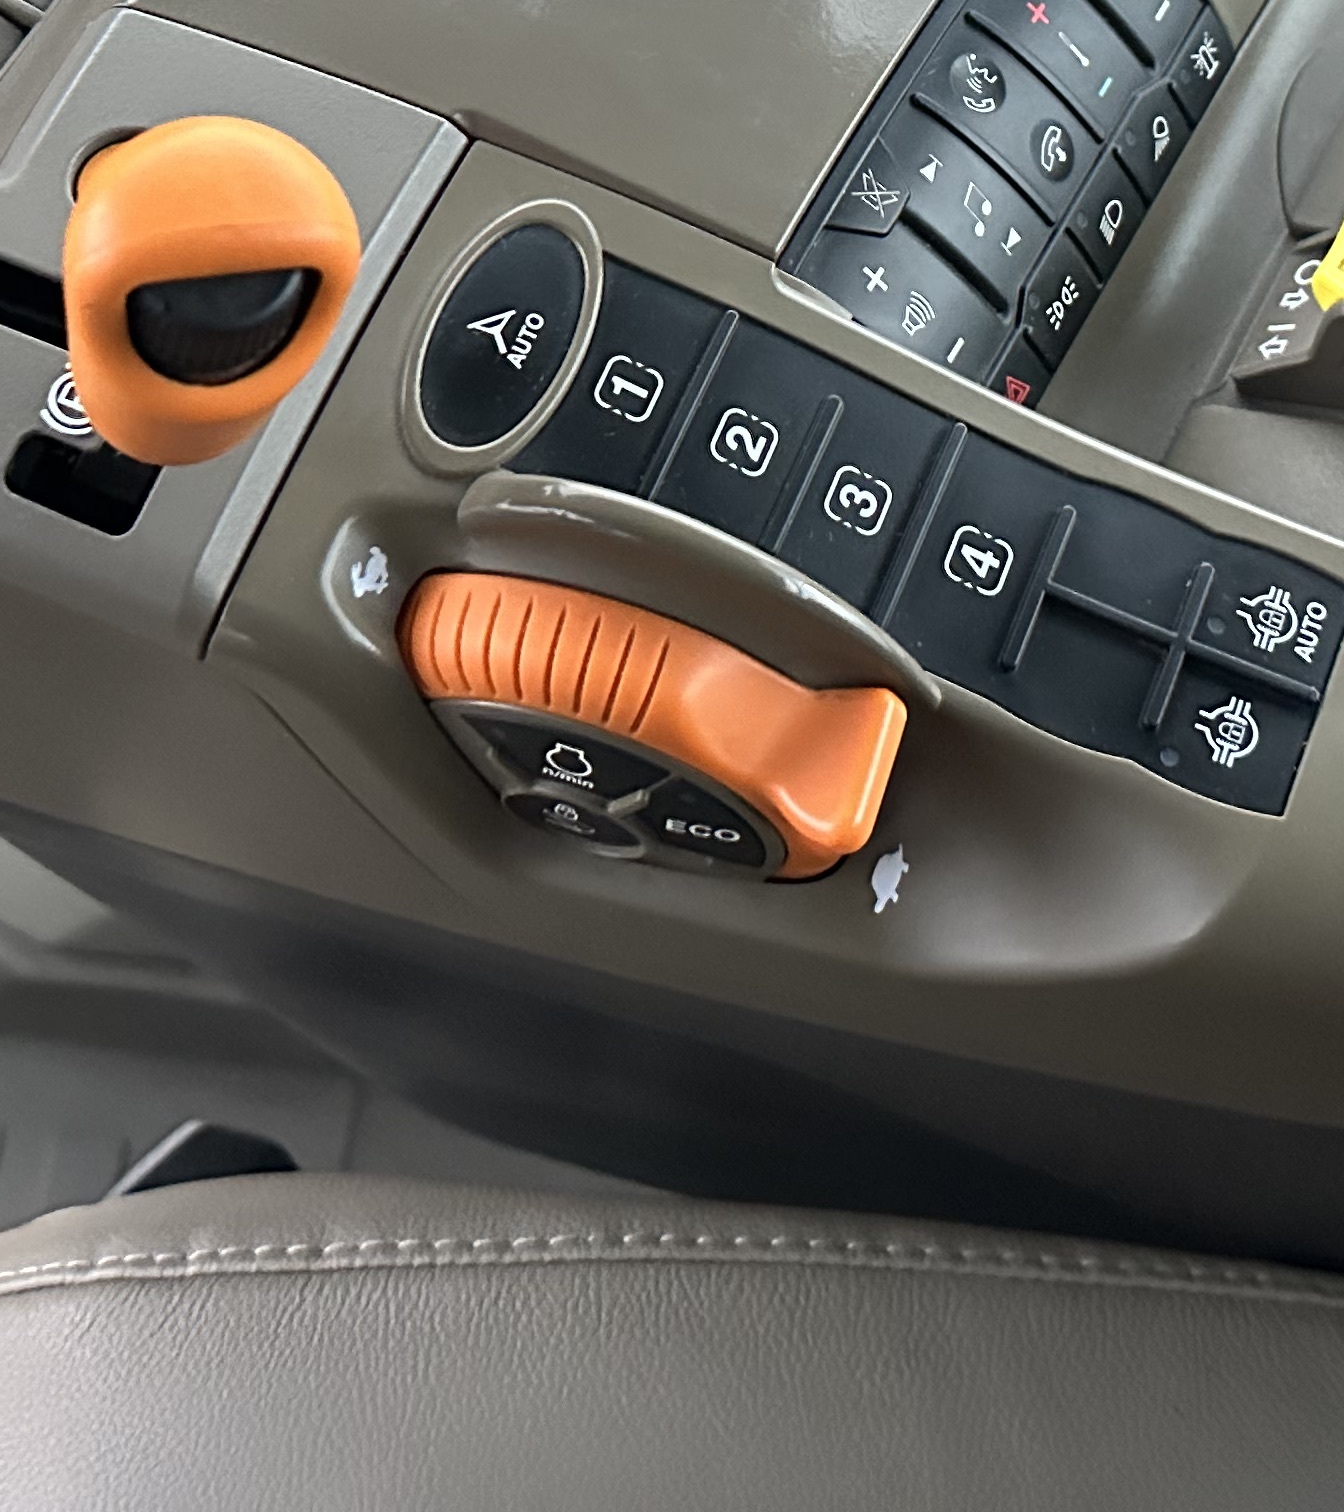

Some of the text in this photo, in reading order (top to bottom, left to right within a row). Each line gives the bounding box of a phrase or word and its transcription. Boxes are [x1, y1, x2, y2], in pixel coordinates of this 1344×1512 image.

[506, 312, 545, 370] AUTO
[611, 375, 649, 399] 1
[724, 424, 768, 462] 2
[838, 483, 878, 519] 3
[960, 543, 1001, 579] 4
[1293, 601, 1328, 664] AUTO
[664, 818, 742, 843] ECO
